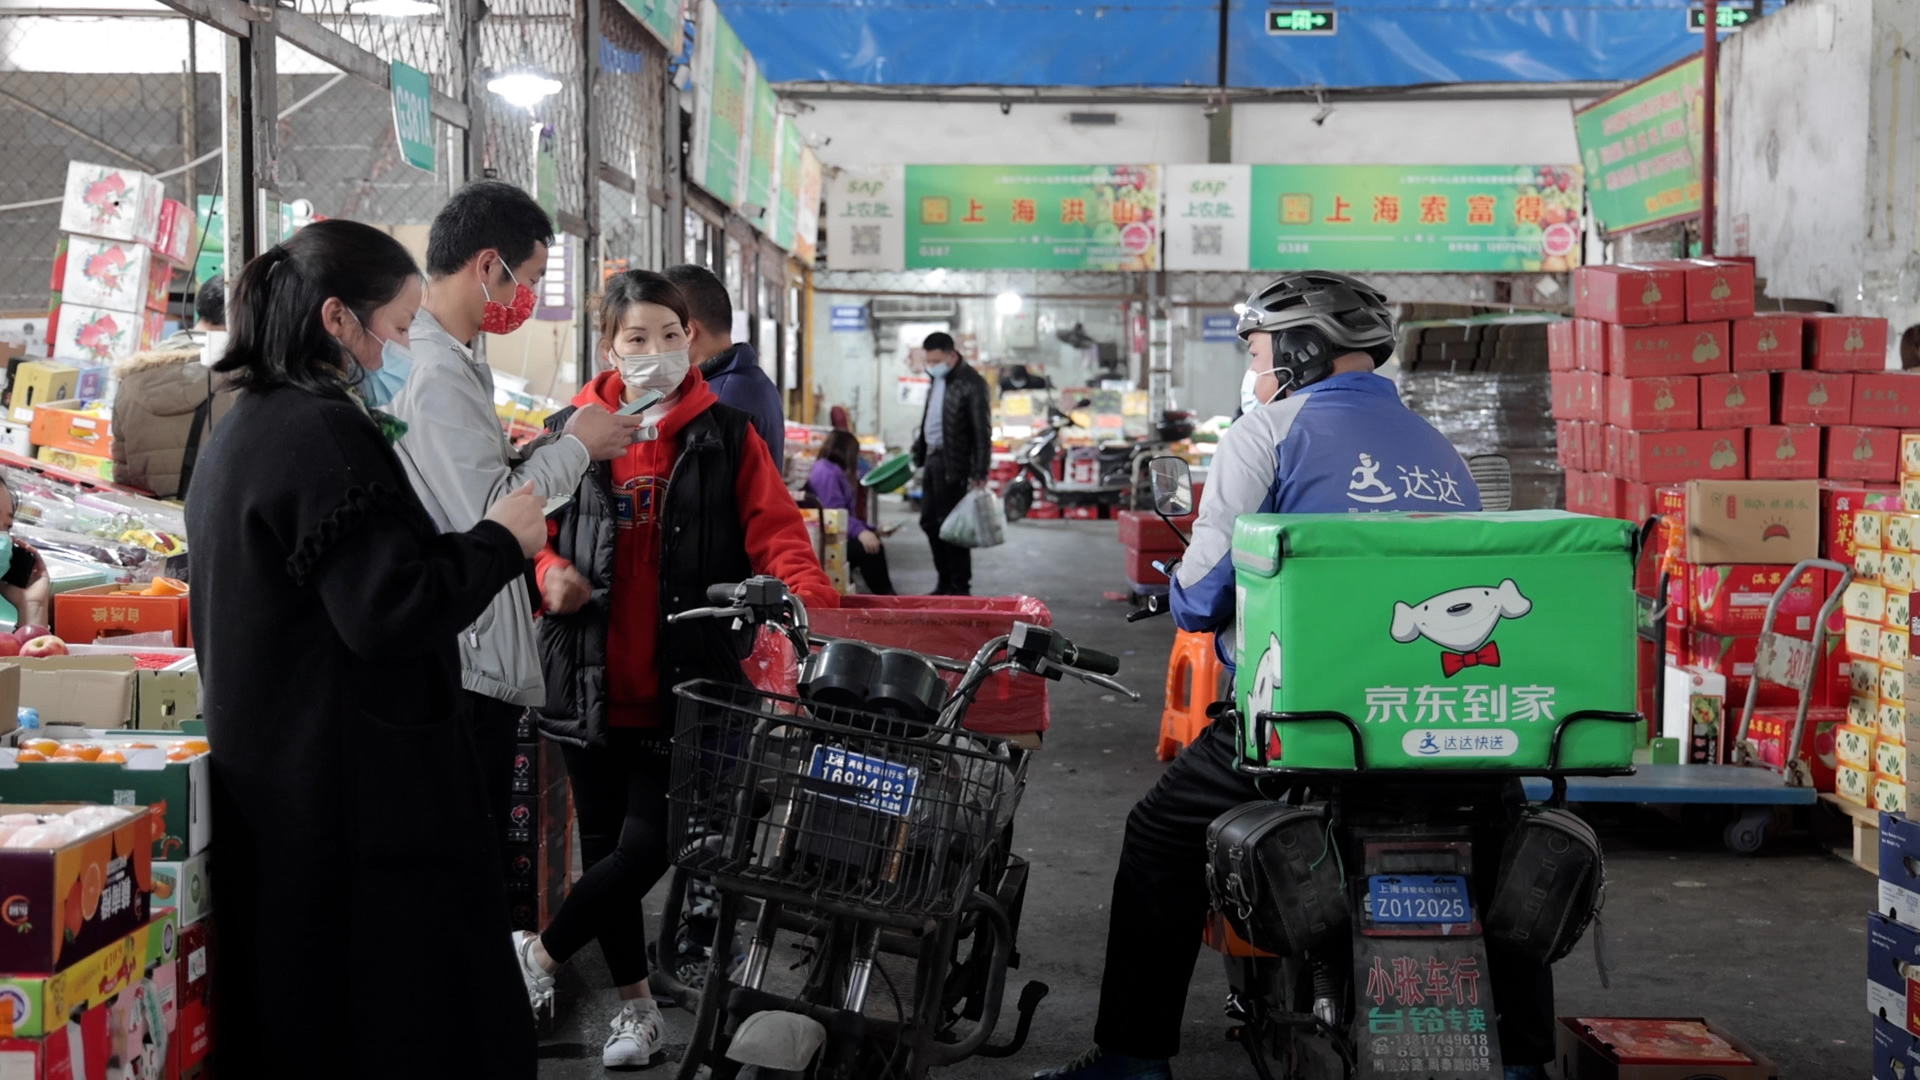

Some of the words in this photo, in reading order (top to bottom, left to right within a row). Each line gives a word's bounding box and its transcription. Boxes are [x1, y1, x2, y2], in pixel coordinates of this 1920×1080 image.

[961, 197, 1134, 225] 上海洪山
[1325, 195, 1543, 225] 上海索富得
[1396, 465, 1466, 507] 达达
[1364, 684, 1556, 723] 京东到家
[1444, 735, 1504, 750] 达达快送
[1377, 898, 1465, 918] Z012025
[1365, 956, 1480, 1006] 小张车行
[1368, 1006, 1487, 1034] 台铃专卖
